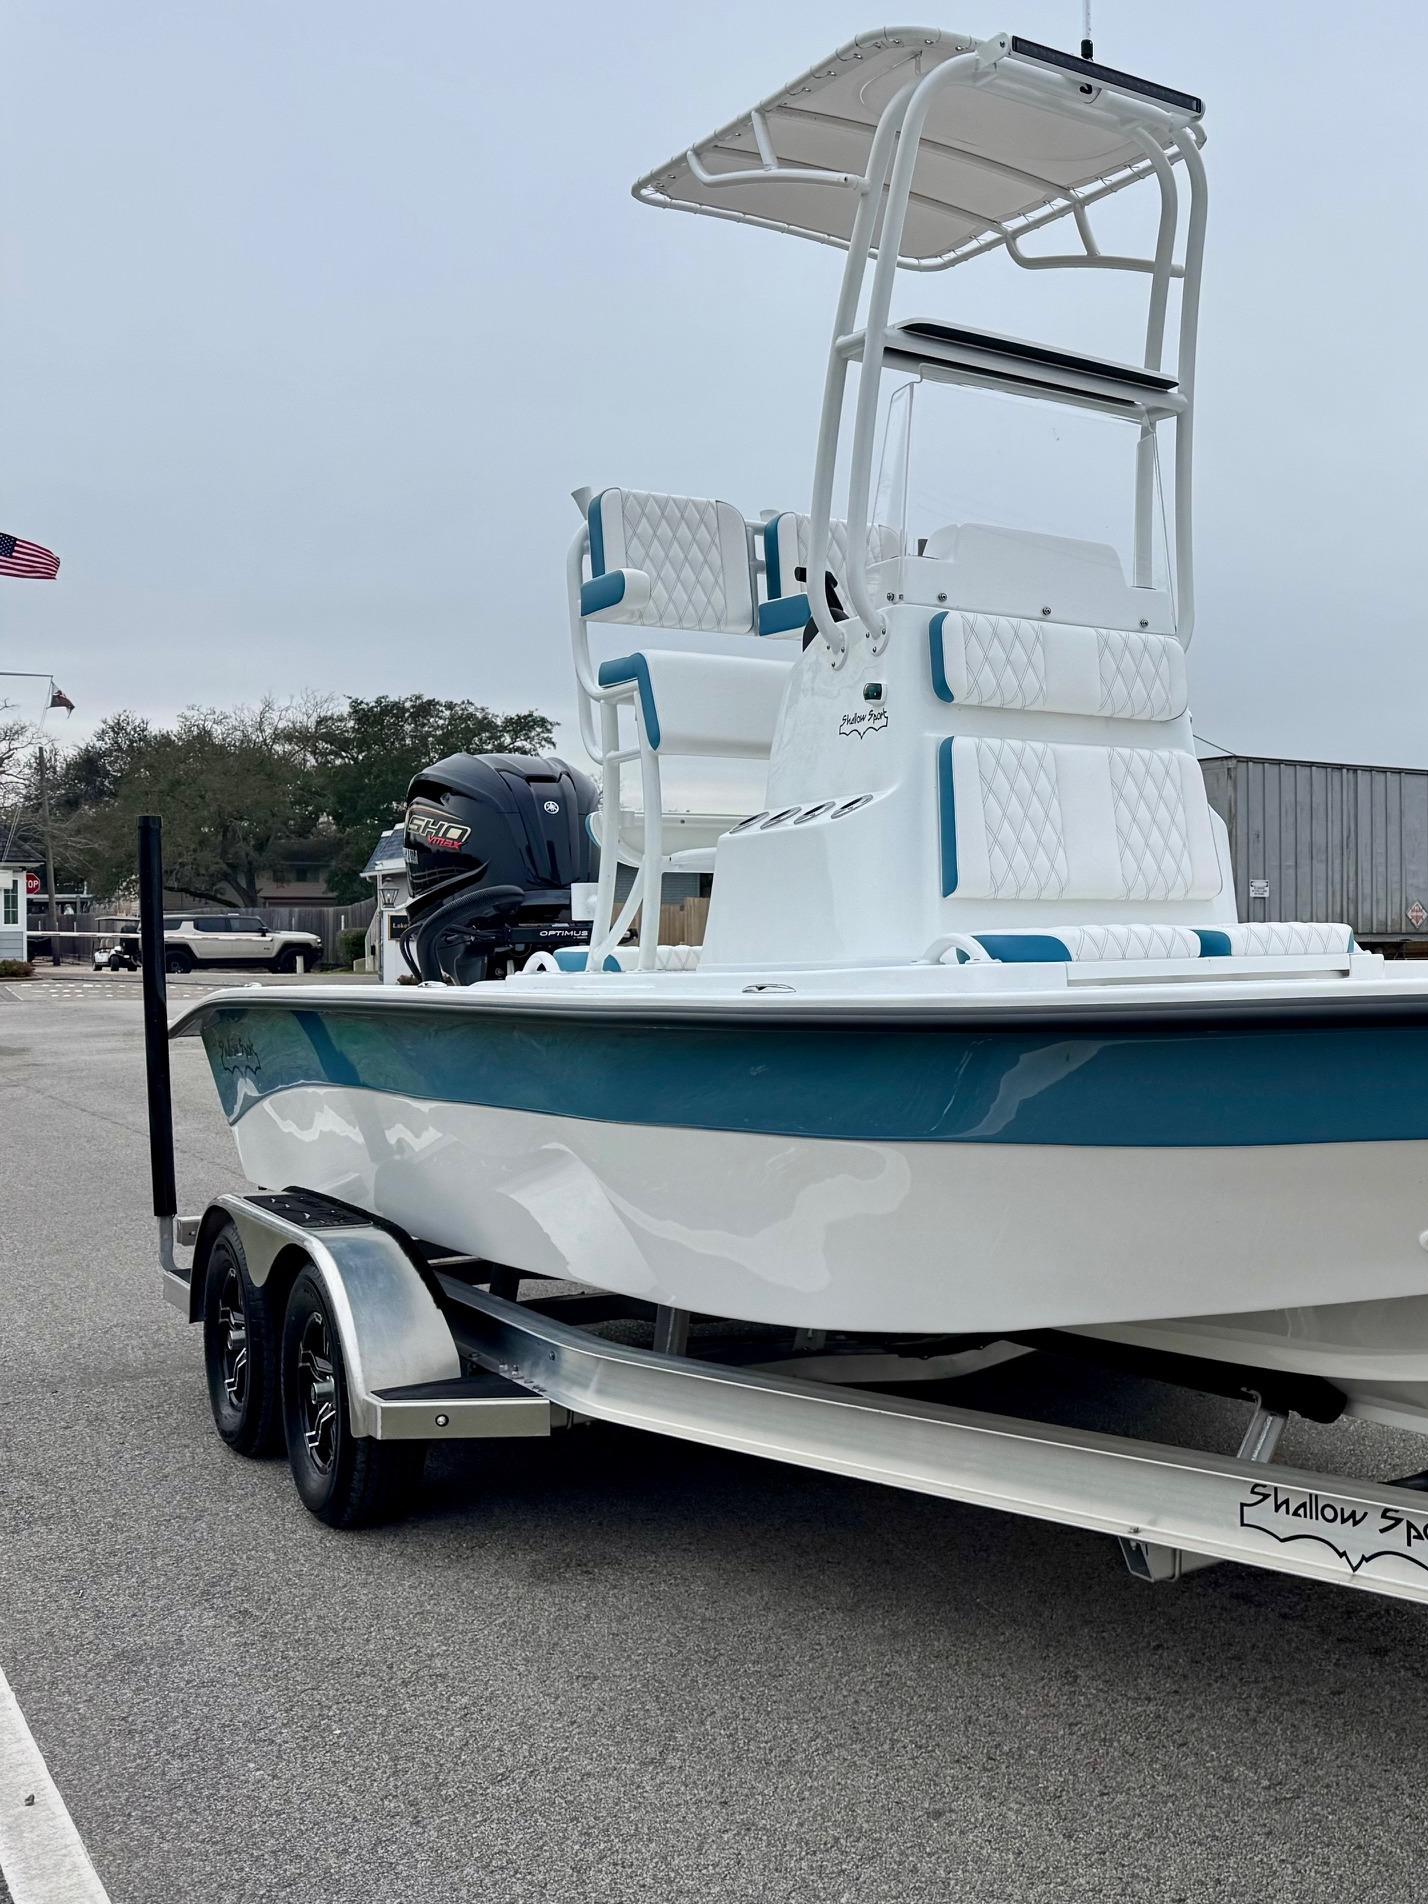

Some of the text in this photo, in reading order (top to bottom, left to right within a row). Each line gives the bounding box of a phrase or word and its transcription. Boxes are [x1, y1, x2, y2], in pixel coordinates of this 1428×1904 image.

[842, 708, 887, 725] Shallow Sport
[408, 815, 471, 843] SHO
[1248, 1483, 1369, 1527] Shallow
